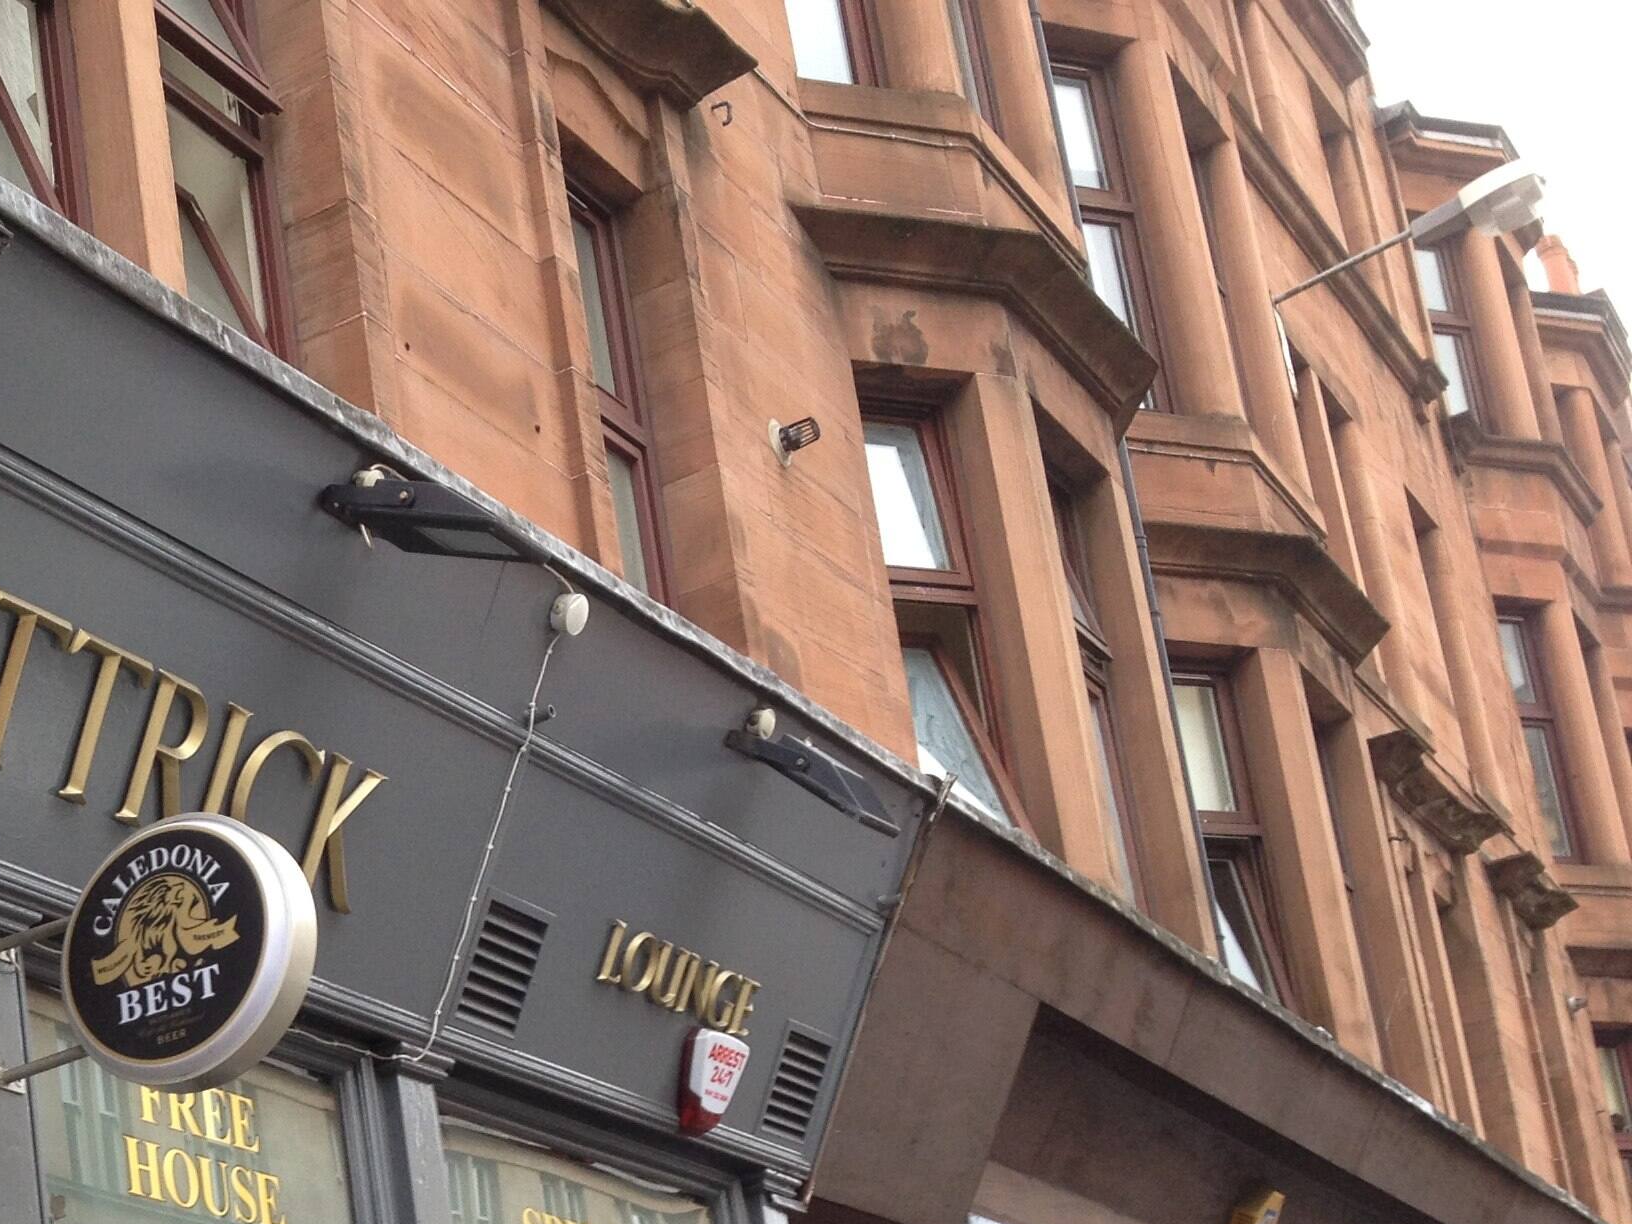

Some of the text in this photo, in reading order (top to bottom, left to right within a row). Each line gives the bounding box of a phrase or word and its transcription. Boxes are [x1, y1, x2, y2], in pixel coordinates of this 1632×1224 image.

[93, 844, 230, 937] CALEDONIA
[116, 963, 220, 1025] BEST
[597, 919, 761, 1036] LOUNGE
[140, 1085, 260, 1153] FREE
